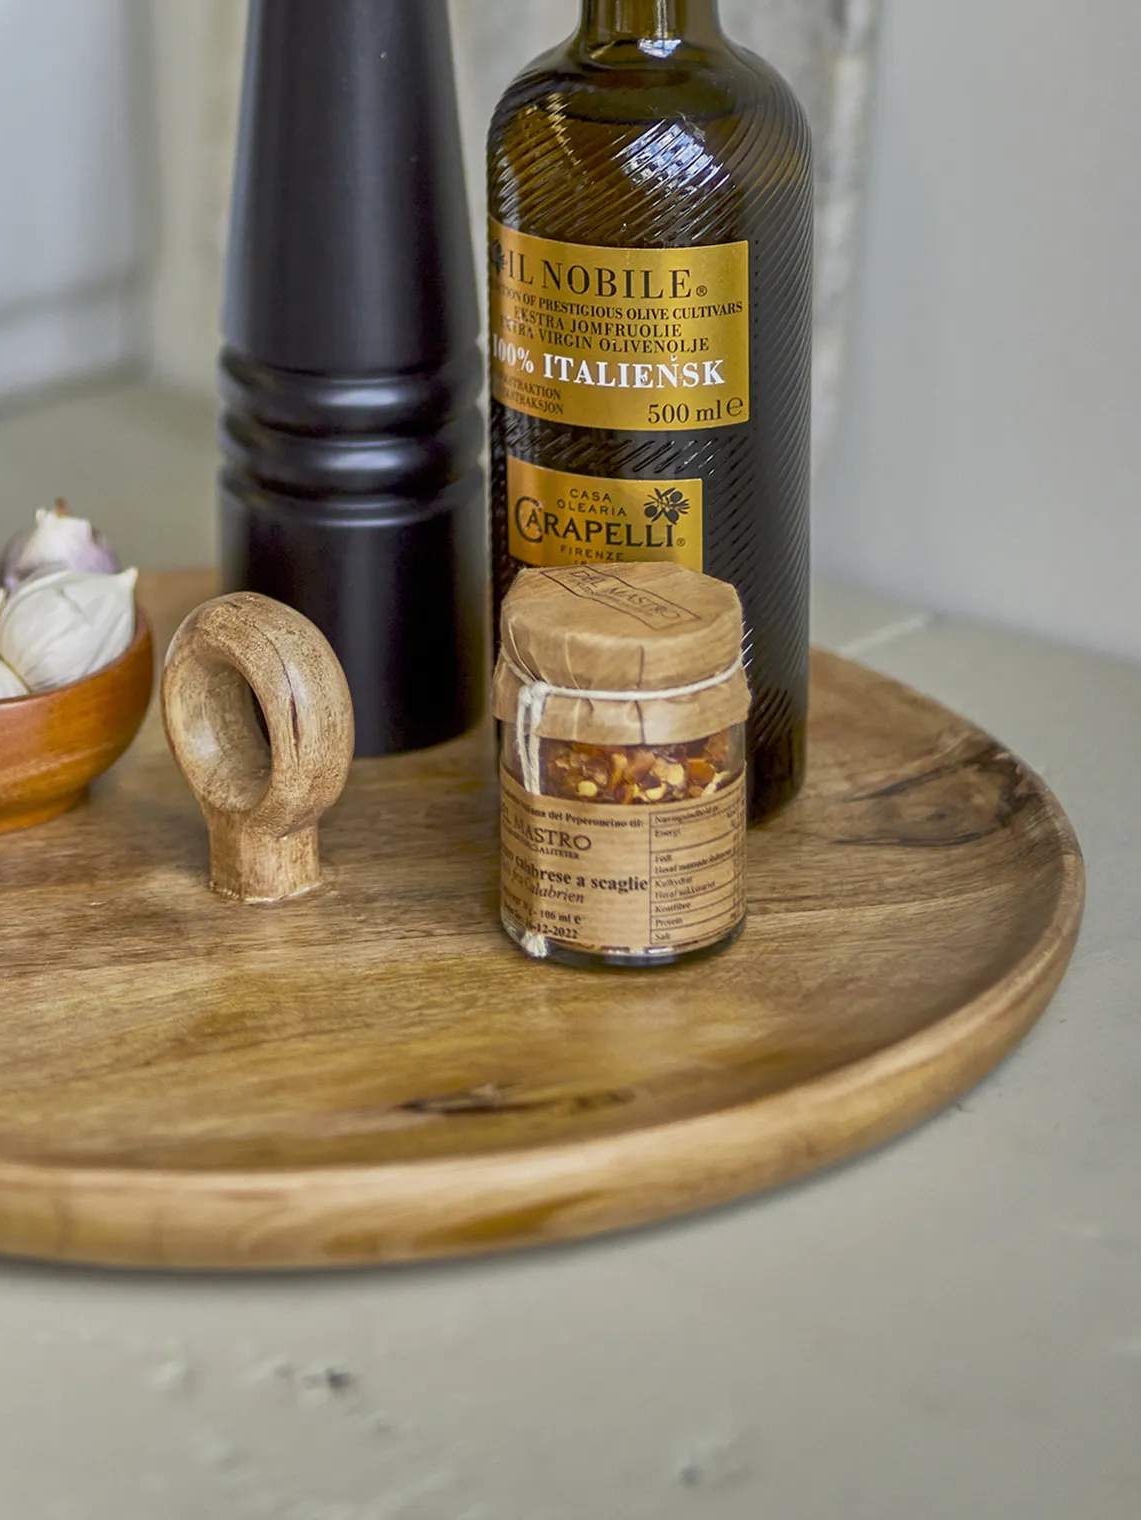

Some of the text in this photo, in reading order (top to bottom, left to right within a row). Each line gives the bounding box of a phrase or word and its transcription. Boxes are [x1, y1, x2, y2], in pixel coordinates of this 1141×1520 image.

[508, 250, 534, 285] IL
[522, 292, 537, 306] OF
[538, 296, 623, 319] PRESTIGIOUS
[626, 307, 669, 320] OLIVE
[672, 301, 743, 319] CULTIVARS
[539, 327, 592, 349] VIRGIN
[600, 337, 710, 353] OLIVENOLJE
[570, 318, 682, 338] JOMFRUOLIE
[493, 333, 535, 373] 100%
[648, 403, 689, 424] 500
[696, 400, 722, 421] ml
[557, 498, 627, 517] OLEARIA
[570, 488, 612, 503] CASA
[560, 544, 624, 562] FIRENZE
[514, 814, 592, 851] MASTRO
[576, 873, 586, 888] a
[590, 876, 649, 895] scaglie
